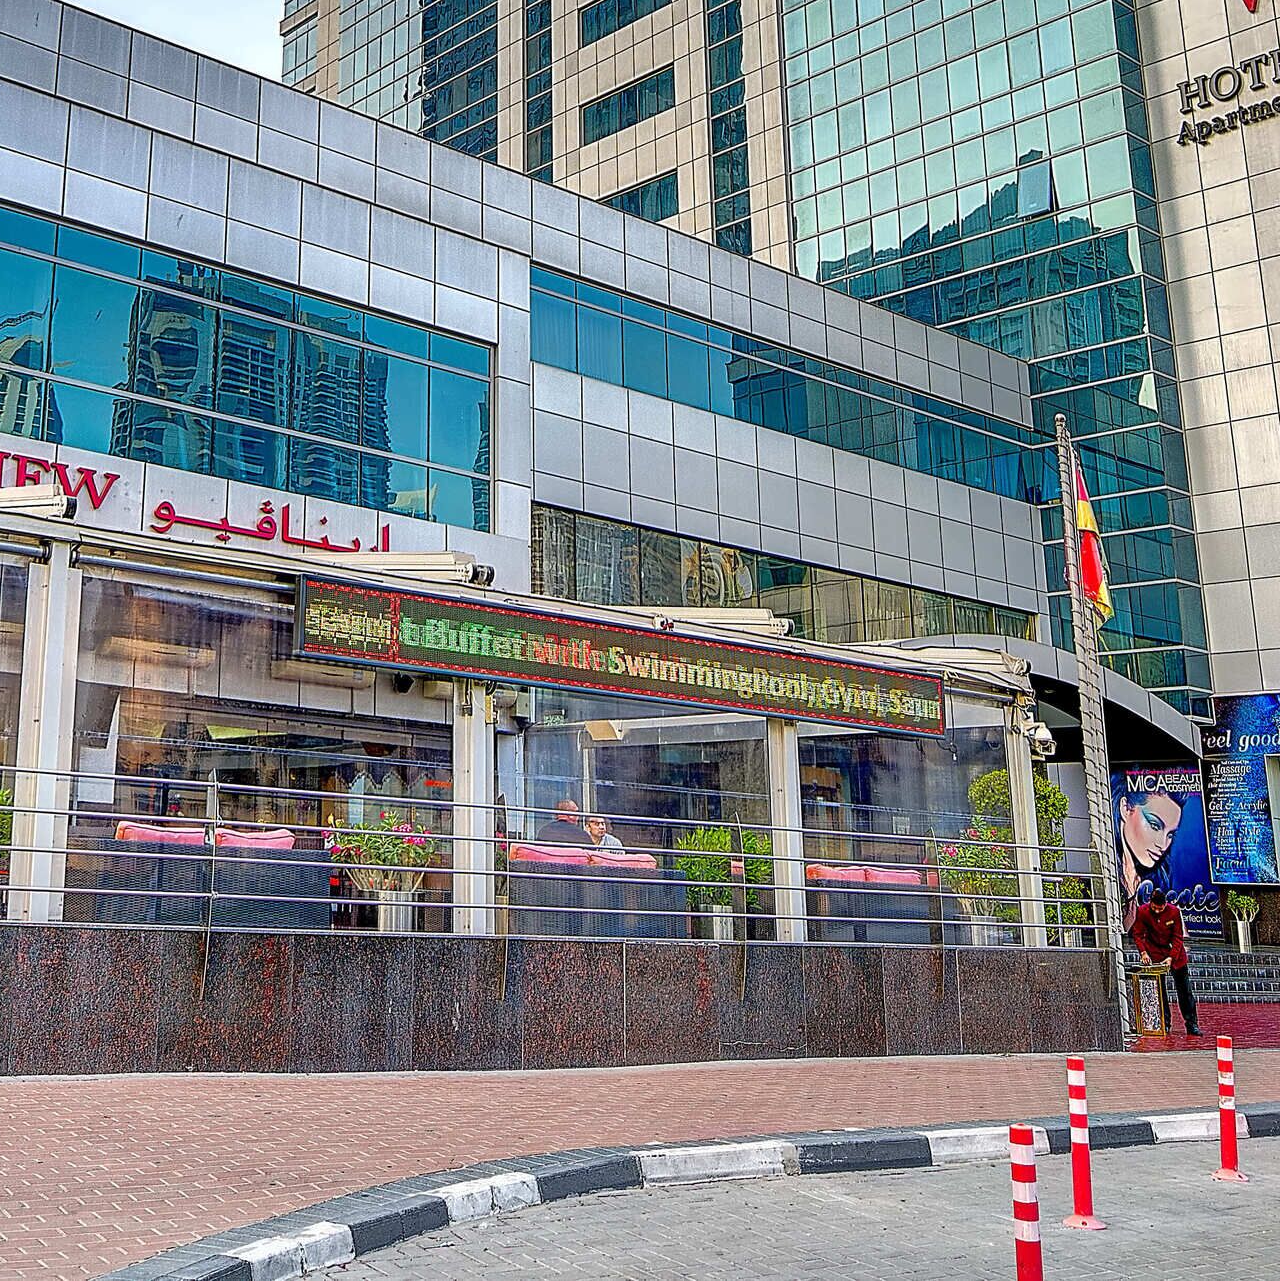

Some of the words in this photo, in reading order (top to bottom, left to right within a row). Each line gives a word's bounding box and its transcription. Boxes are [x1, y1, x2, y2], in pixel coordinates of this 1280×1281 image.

[1202, 729, 1232, 749] eel
[1210, 764, 1252, 777] Massage
[1125, 774, 1169, 793] MICA
[1165, 773, 1201, 784] BEAUT
[1167, 783, 1201, 792] cosmeti
[1208, 800, 1223, 811] Gel
[1136, 879, 1221, 912] Ceate
[1181, 913, 1203, 923] erfect
[1204, 914, 1222, 924] look
